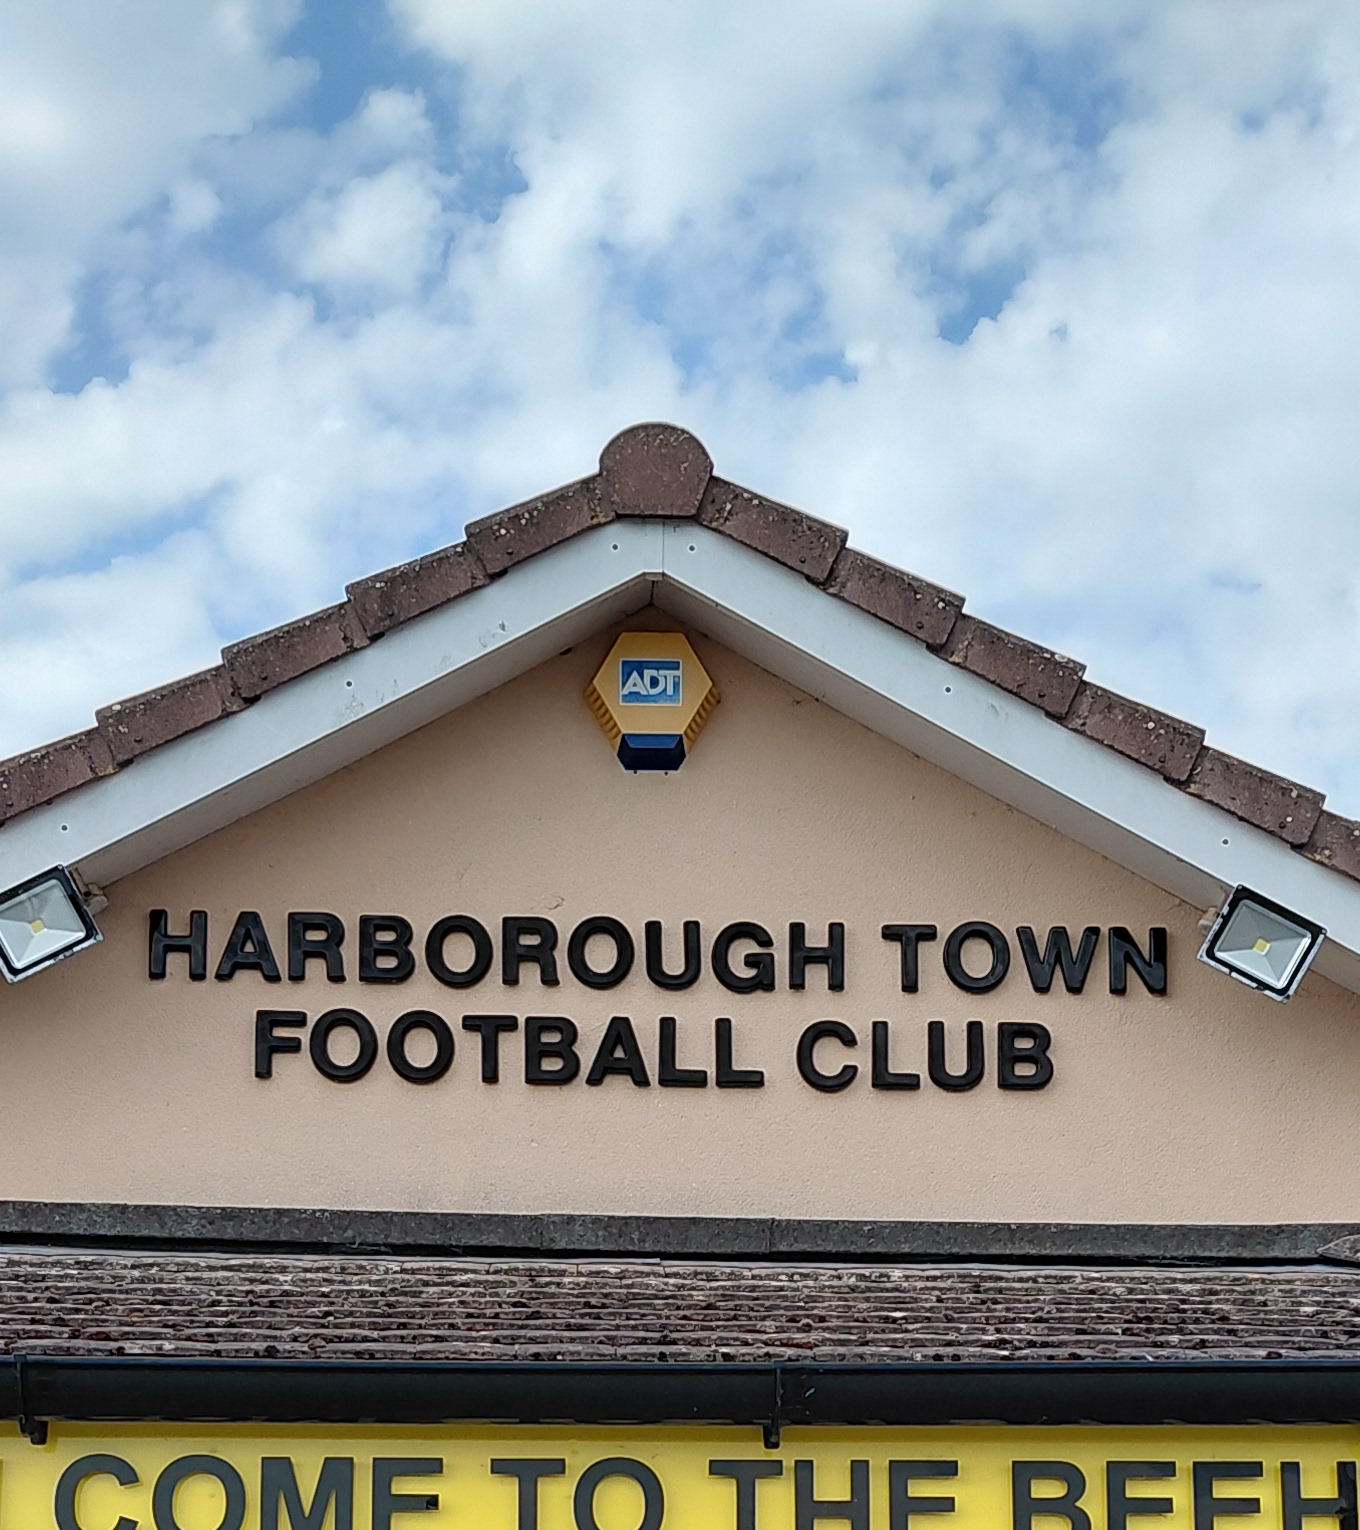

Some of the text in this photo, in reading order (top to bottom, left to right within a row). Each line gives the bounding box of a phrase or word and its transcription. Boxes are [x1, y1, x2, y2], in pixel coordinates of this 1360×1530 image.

[621, 669, 681, 696] ADT
[148, 908, 1168, 997] HARBOROUGH TOWN
[254, 1007, 1055, 1093] FOOTBALL CLUB
